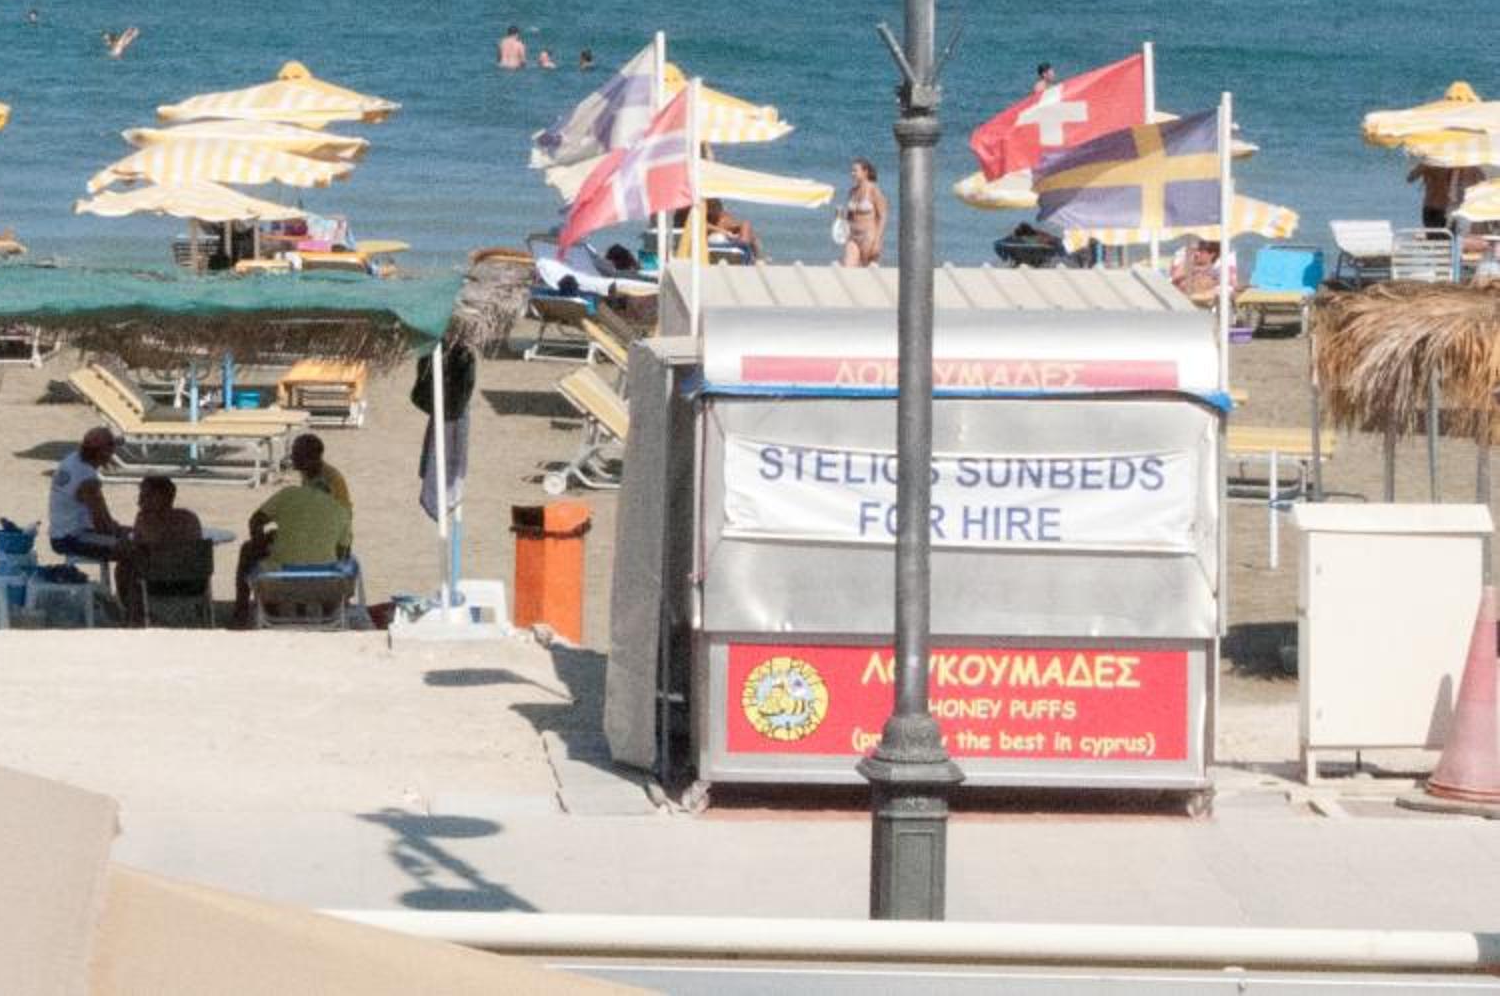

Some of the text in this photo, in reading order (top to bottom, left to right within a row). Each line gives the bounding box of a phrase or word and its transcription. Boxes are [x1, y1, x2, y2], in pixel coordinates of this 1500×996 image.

[955, 456, 1165, 492] SUNBEDS
[962, 505, 1062, 542] HIRE
[861, 651, 1141, 688] ΛΚΟΥΜΑΔΕΣ
[927, 698, 1077, 720] HONEY PUFFS
[957, 730, 991, 750] the
[999, 731, 1045, 751] best
[1054, 731, 1071, 751] in
[1079, 733, 1156, 755] cyprus)
